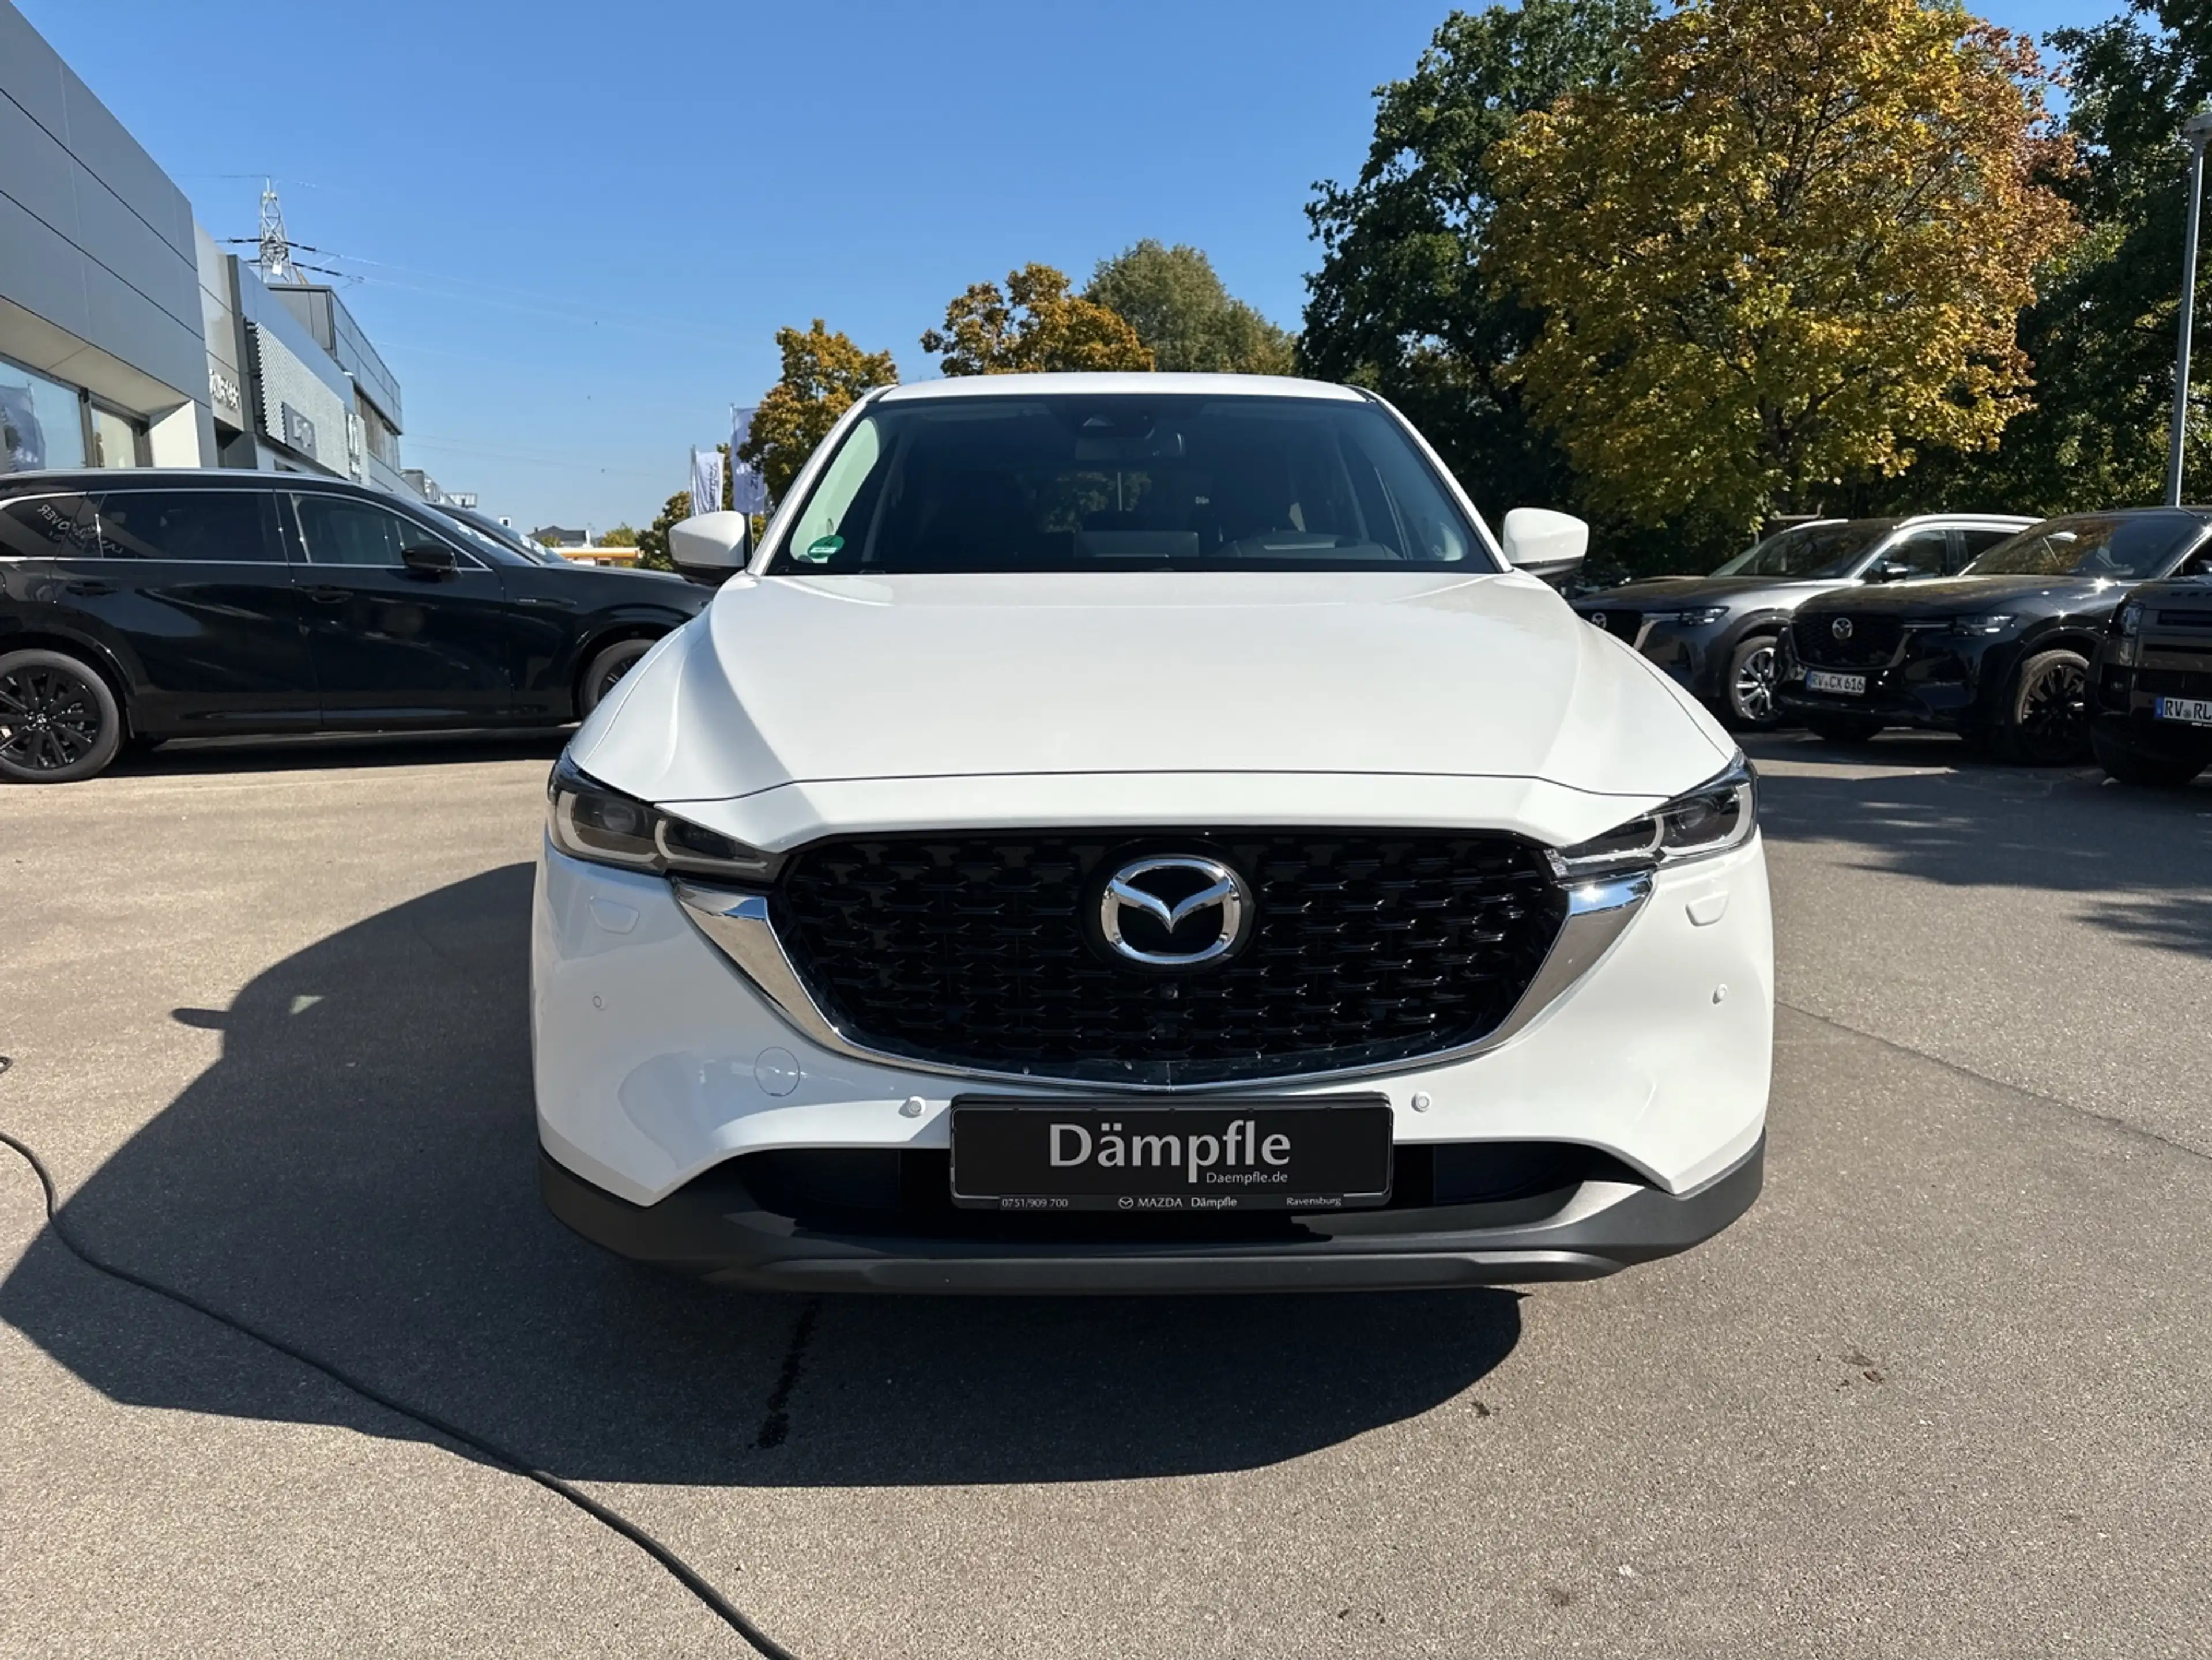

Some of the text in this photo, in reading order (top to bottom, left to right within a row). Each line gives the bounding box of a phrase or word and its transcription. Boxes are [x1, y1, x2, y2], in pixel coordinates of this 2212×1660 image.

[1844, 677, 1864, 691] 616
[2165, 700, 2184, 717] RV
[1050, 1120, 1291, 1183] Dämpfle
[1207, 1171, 1288, 1185] Daempfle.de
[1050, 1198, 1068, 1208] 700
[1137, 1198, 1183, 1208] MAZDA
[1191, 1196, 1237, 1209] Dämpfle
[1286, 1196, 1341, 1206] Ravensburg
